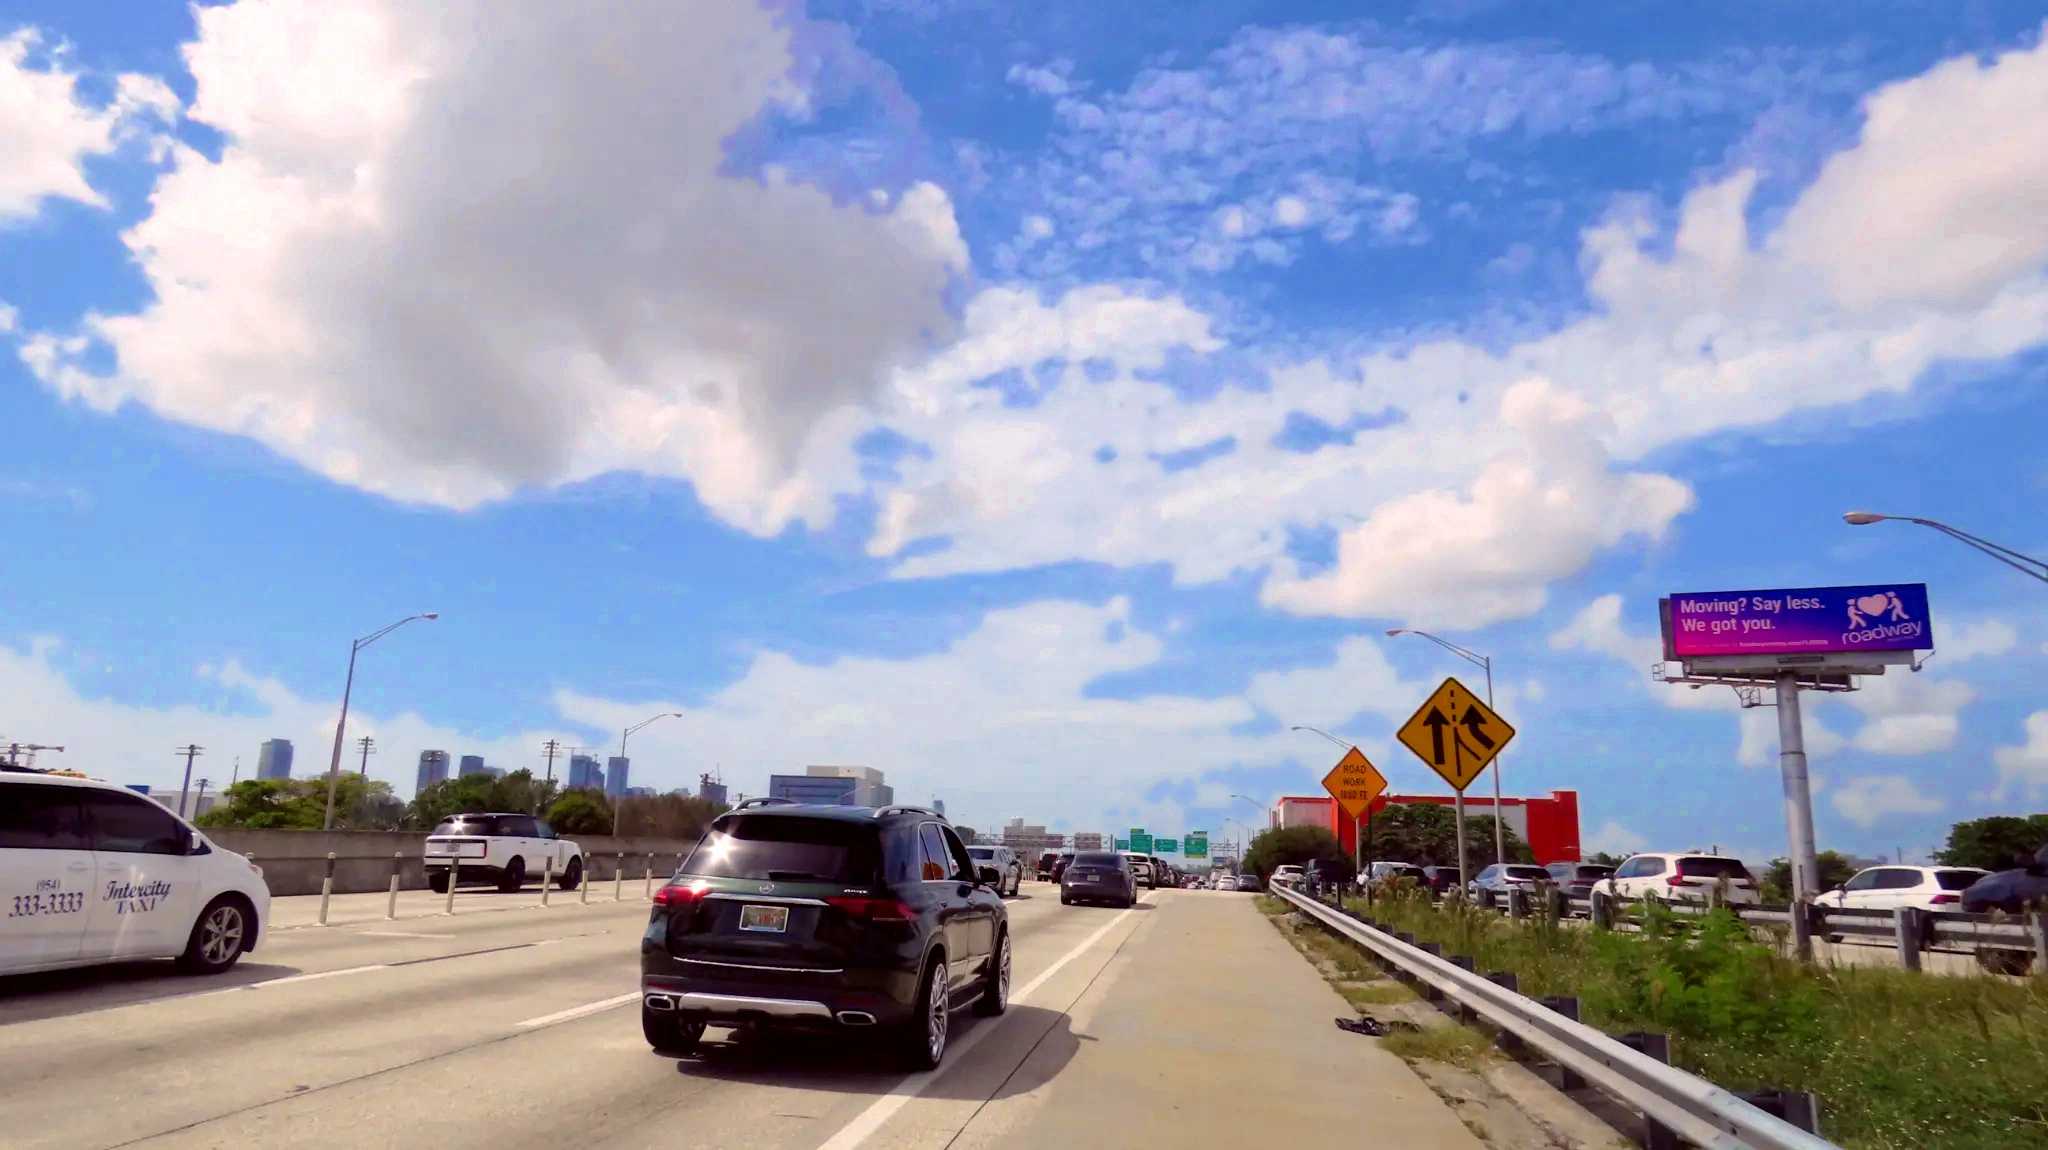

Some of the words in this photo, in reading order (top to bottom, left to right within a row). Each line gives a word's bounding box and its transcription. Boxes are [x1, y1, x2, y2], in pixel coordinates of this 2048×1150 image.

[1680, 598, 1747, 615] Moving?
[1752, 597, 1781, 613] Say
[1786, 595, 1825, 610] less.
[1681, 617, 1706, 632] We
[1711, 617, 1737, 634] got
[1742, 617, 1776, 633] you.
[1841, 620, 1921, 645] roadway
[1343, 764, 1367, 774] ROAD
[1343, 777, 1366, 786] WORK
[36, 879, 61, 891] (954)
[102, 880, 172, 901] Intercity
[8, 892, 84, 918] 333-3333
[116, 899, 156, 914] TAXI
